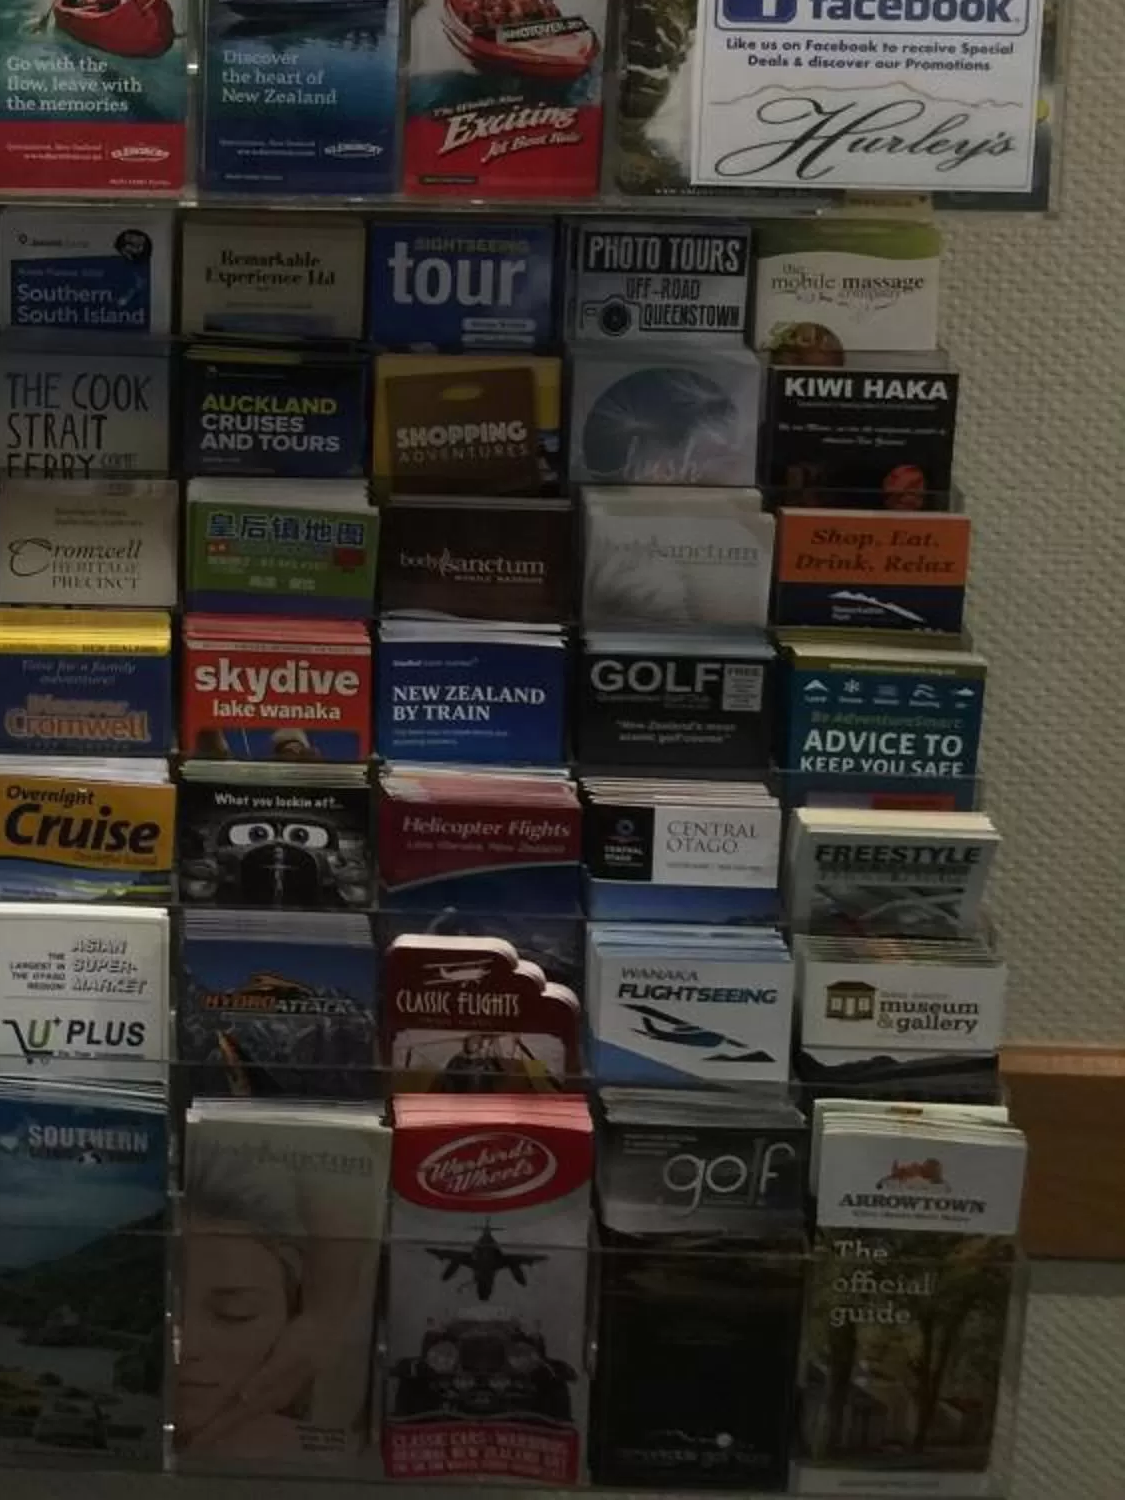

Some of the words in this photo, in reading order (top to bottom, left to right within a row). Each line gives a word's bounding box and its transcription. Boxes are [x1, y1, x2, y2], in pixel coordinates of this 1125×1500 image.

[727, 38, 756, 51] Like
[761, 41, 777, 51] us
[783, 41, 801, 51] on
[806, 39, 877, 53] Facebook
[883, 42, 897, 53] to
[903, 43, 956, 54] receive
[962, 42, 1014, 56] Special
[749, 54, 788, 67] Deals
[794, 56, 803, 67] &
[809, 56, 869, 69] discover
[876, 60, 900, 70] our
[905, 58, 990, 71] Promotions
[223, 89, 258, 104] New
[264, 89, 337, 105] Zealand
[714, 97, 1016, 181] Hurley's
[588, 236, 660, 269] PHOTO
[670, 238, 739, 272] TOURS
[388, 241, 526, 307] tour
[17, 285, 113, 302] Southern
[17, 306, 78, 324] South
[84, 306, 145, 325] Island
[785, 377, 852, 398] KIWI
[864, 378, 948, 400] HAKA
[201, 394, 337, 416] AUCKLAND
[201, 415, 304, 433] CRUISES
[396, 420, 527, 449] SHOPPING
[200, 434, 263, 451] AND
[271, 434, 340, 453] TOURS
[195, 657, 359, 703] skydive
[591, 660, 722, 693] GOLF
[393, 686, 439, 703] NEW
[445, 686, 545, 705] ZEALAND
[213, 700, 255, 718] lake
[261, 702, 340, 721] wanaka
[393, 705, 420, 721] BY
[425, 705, 490, 722] TRAIN
[803, 730, 917, 754] ADVICE
[925, 734, 963, 757] TO
[5, 803, 160, 854] Cruise
[879, 999, 979, 1015] museum
[66, 1019, 145, 1047] PLUS
[896, 1014, 978, 1034] gallery
[834, 1240, 889, 1261] The
